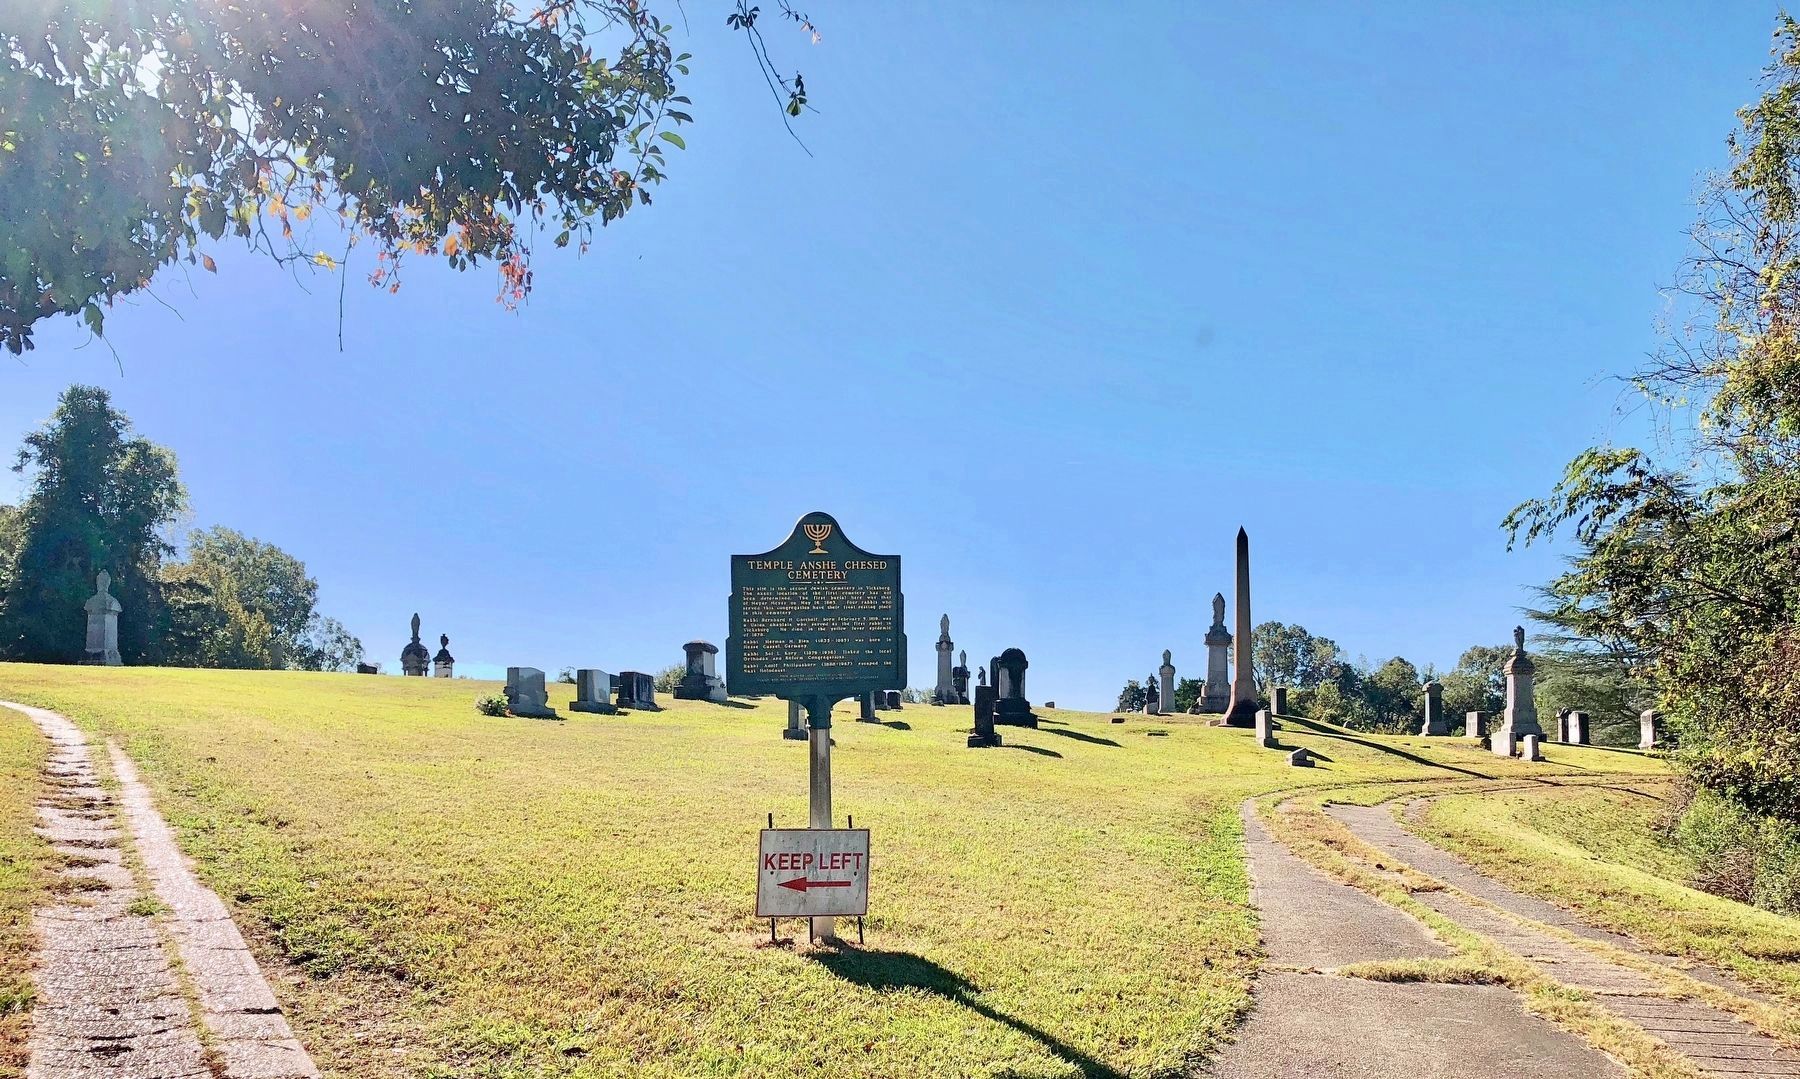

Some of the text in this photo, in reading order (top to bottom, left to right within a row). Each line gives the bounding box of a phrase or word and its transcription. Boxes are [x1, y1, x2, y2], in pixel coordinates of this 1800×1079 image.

[748, 560, 887, 570] TEMPLE ANSHE CHESED
[788, 570, 848, 580] CEMETERY
[764, 852, 864, 870] KEEP LEFT
